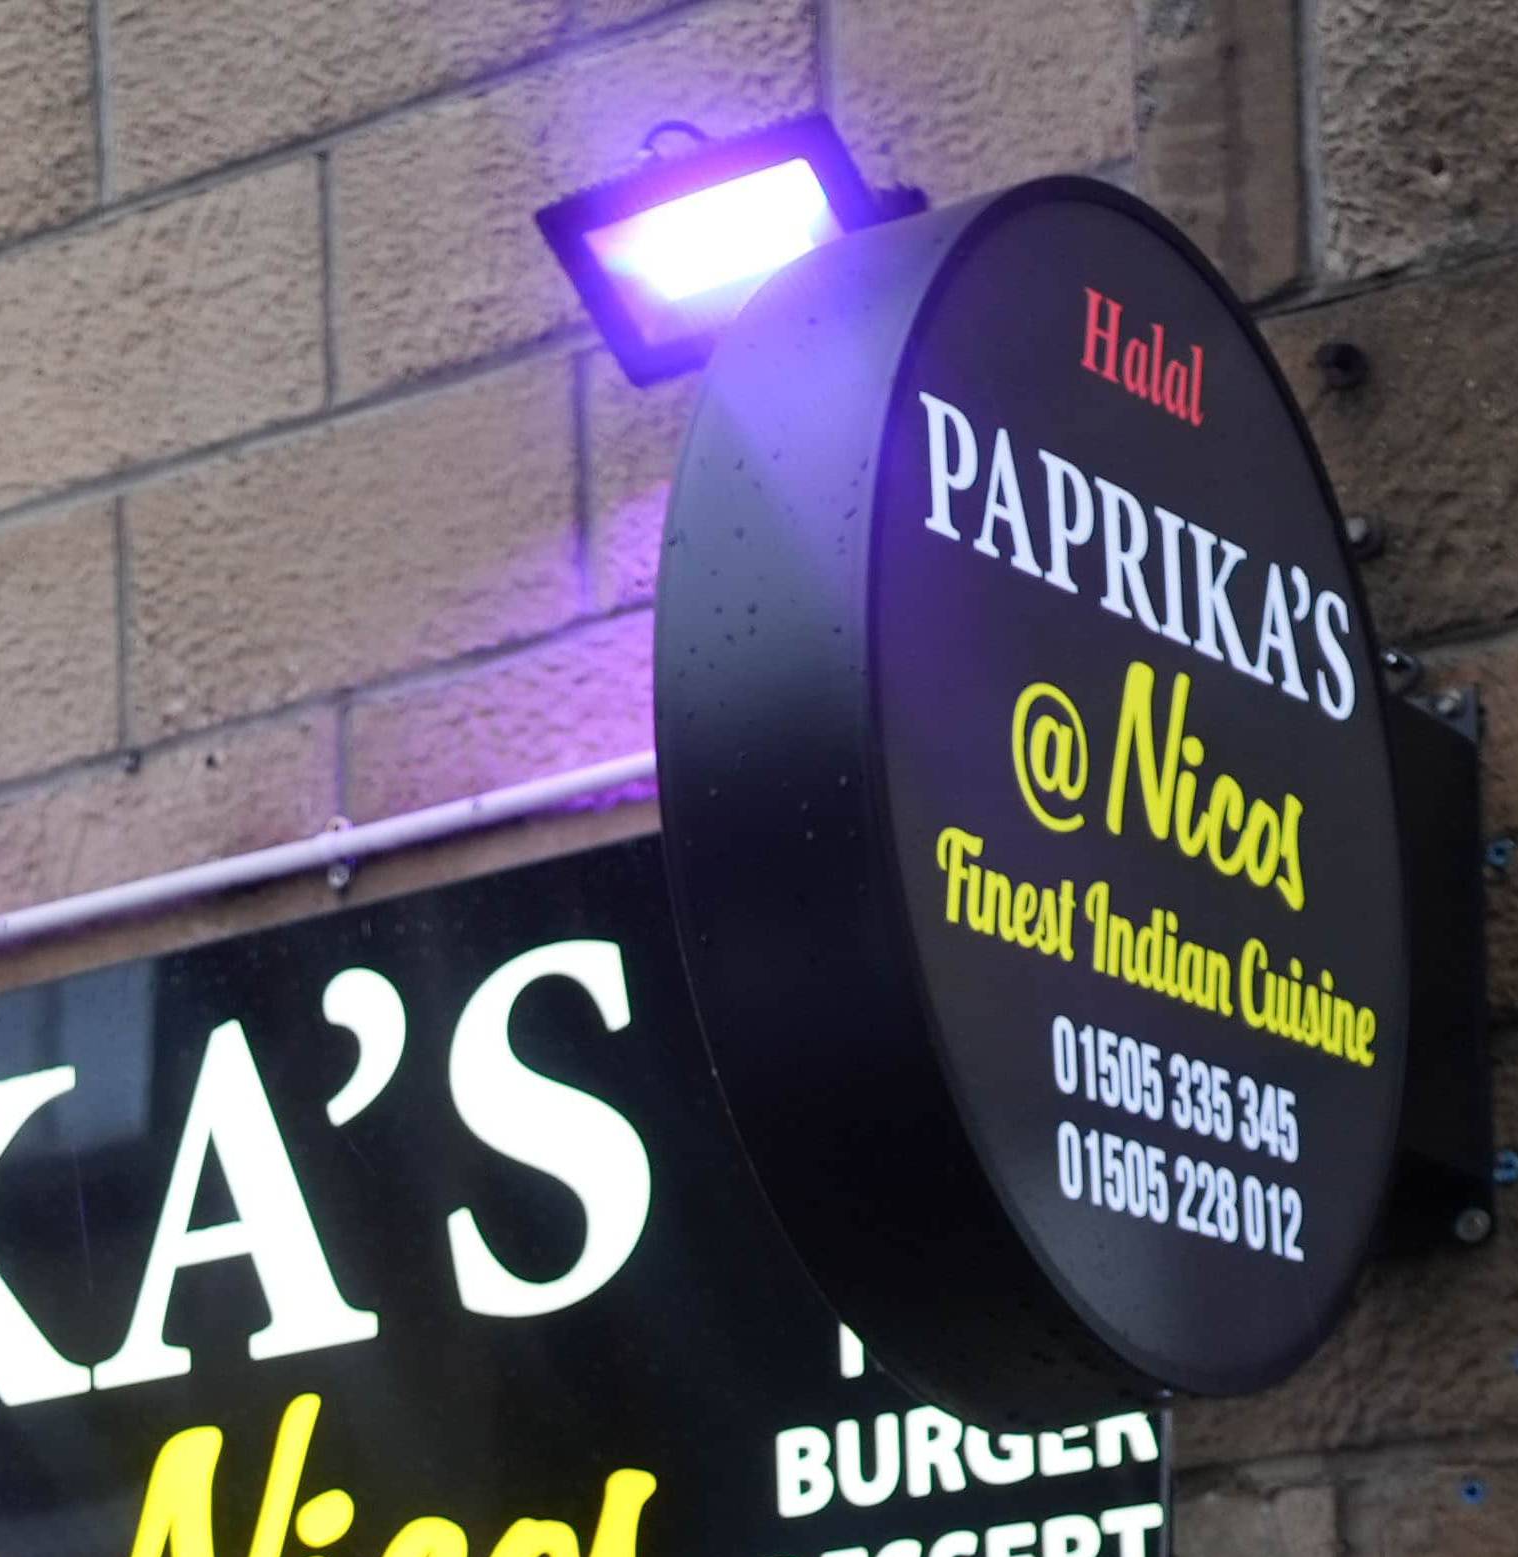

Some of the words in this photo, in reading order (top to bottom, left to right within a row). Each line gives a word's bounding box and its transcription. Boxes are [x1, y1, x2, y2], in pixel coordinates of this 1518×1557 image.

[1082, 288, 1203, 426] Halal
[920, 392, 1355, 722] PAPRIKA'S
[1014, 683, 1088, 832] @
[1108, 662, 1304, 910] Nicos
[937, 827, 1075, 960] Finest
[1085, 881, 1233, 1016] Indian
[1240, 938, 1375, 1066] Cuisine
[1052, 1015, 1164, 1120] 01505
[1169, 1054, 1233, 1142] 335
[1237, 1076, 1299, 1162] 345
[1057, 1121, 1169, 1223] 01505
[1174, 1155, 1238, 1242] 228
[1243, 1187, 1304, 1261] 012
[776, 1405, 1164, 1517] BURGER
